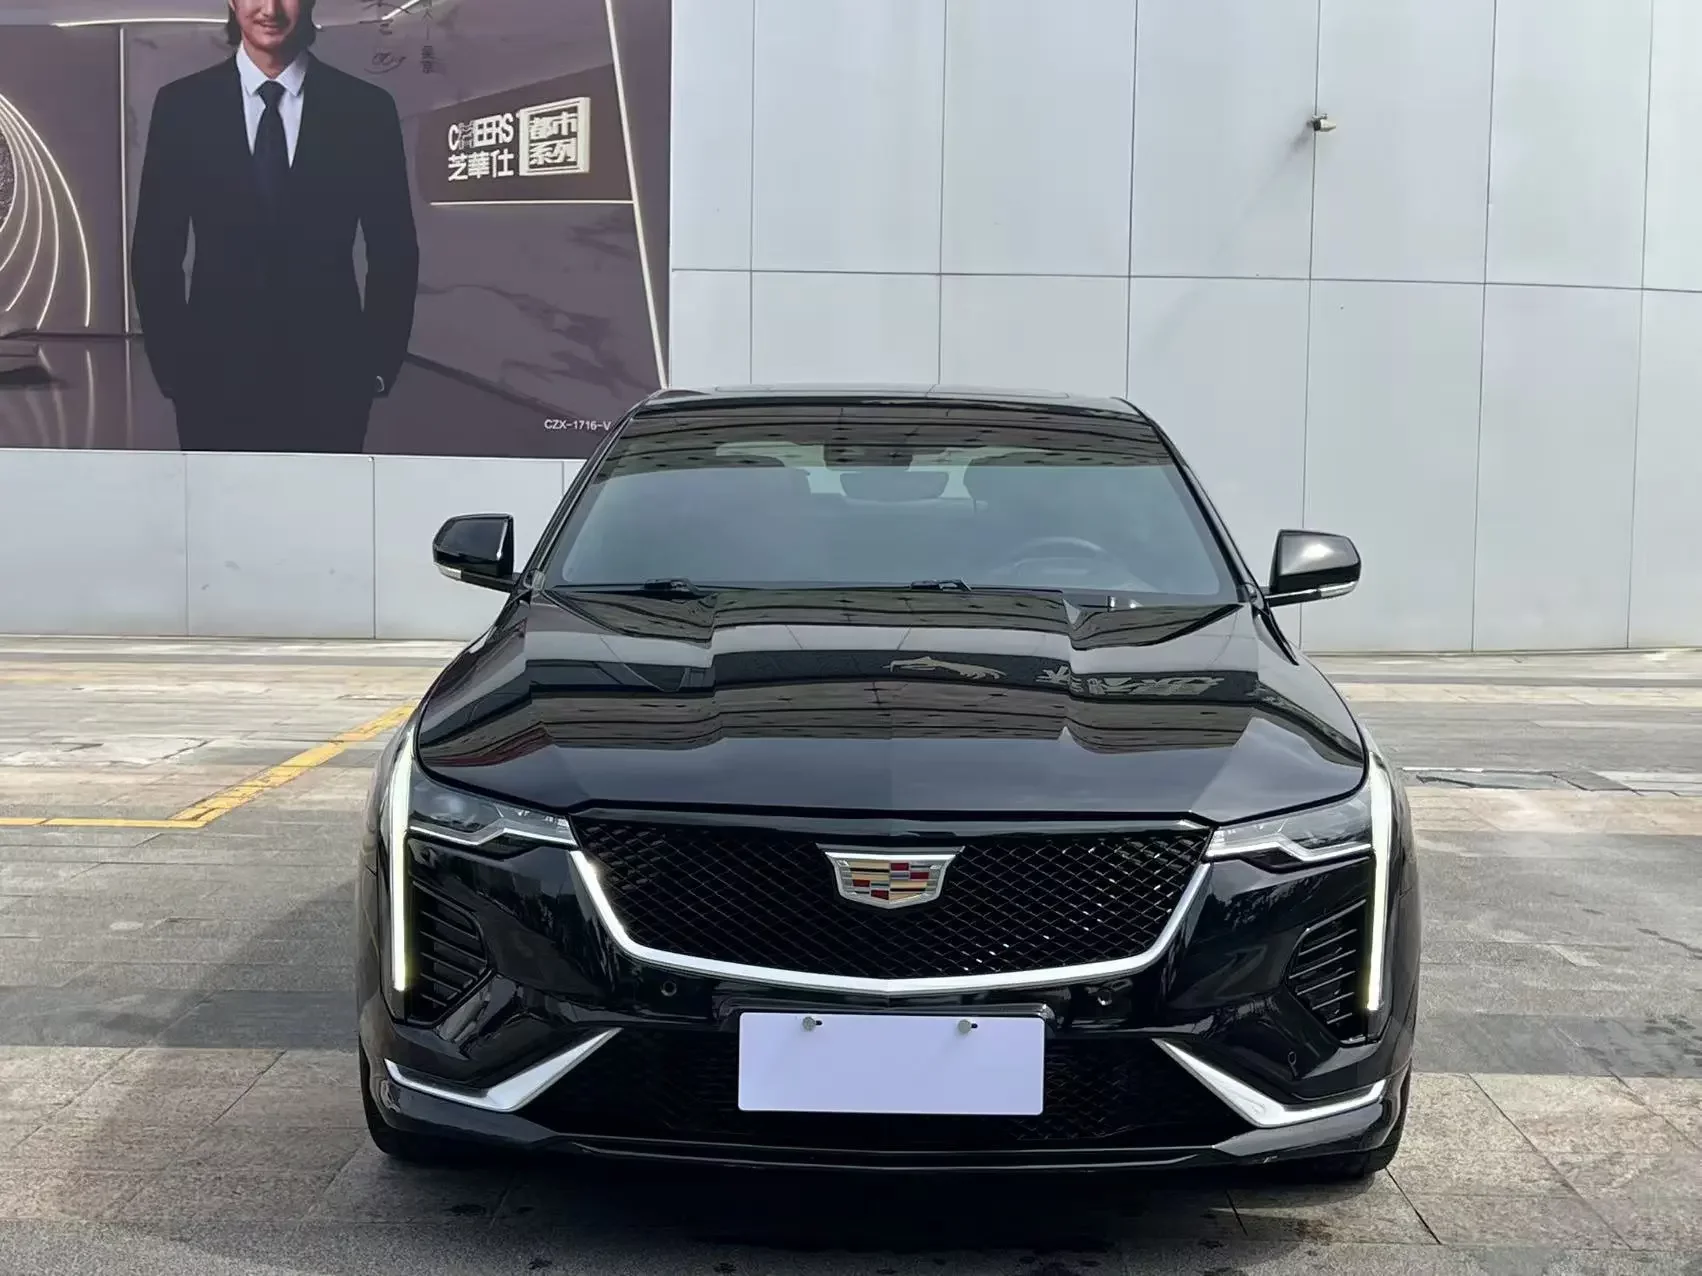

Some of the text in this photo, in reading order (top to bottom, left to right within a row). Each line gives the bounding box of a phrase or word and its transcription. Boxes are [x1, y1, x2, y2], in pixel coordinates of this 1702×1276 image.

[529, 111, 578, 140] 都市
[448, 149, 514, 181] 芝華仕
[529, 138, 577, 165] 系列
[544, 419, 612, 431] CZX-1716-V
